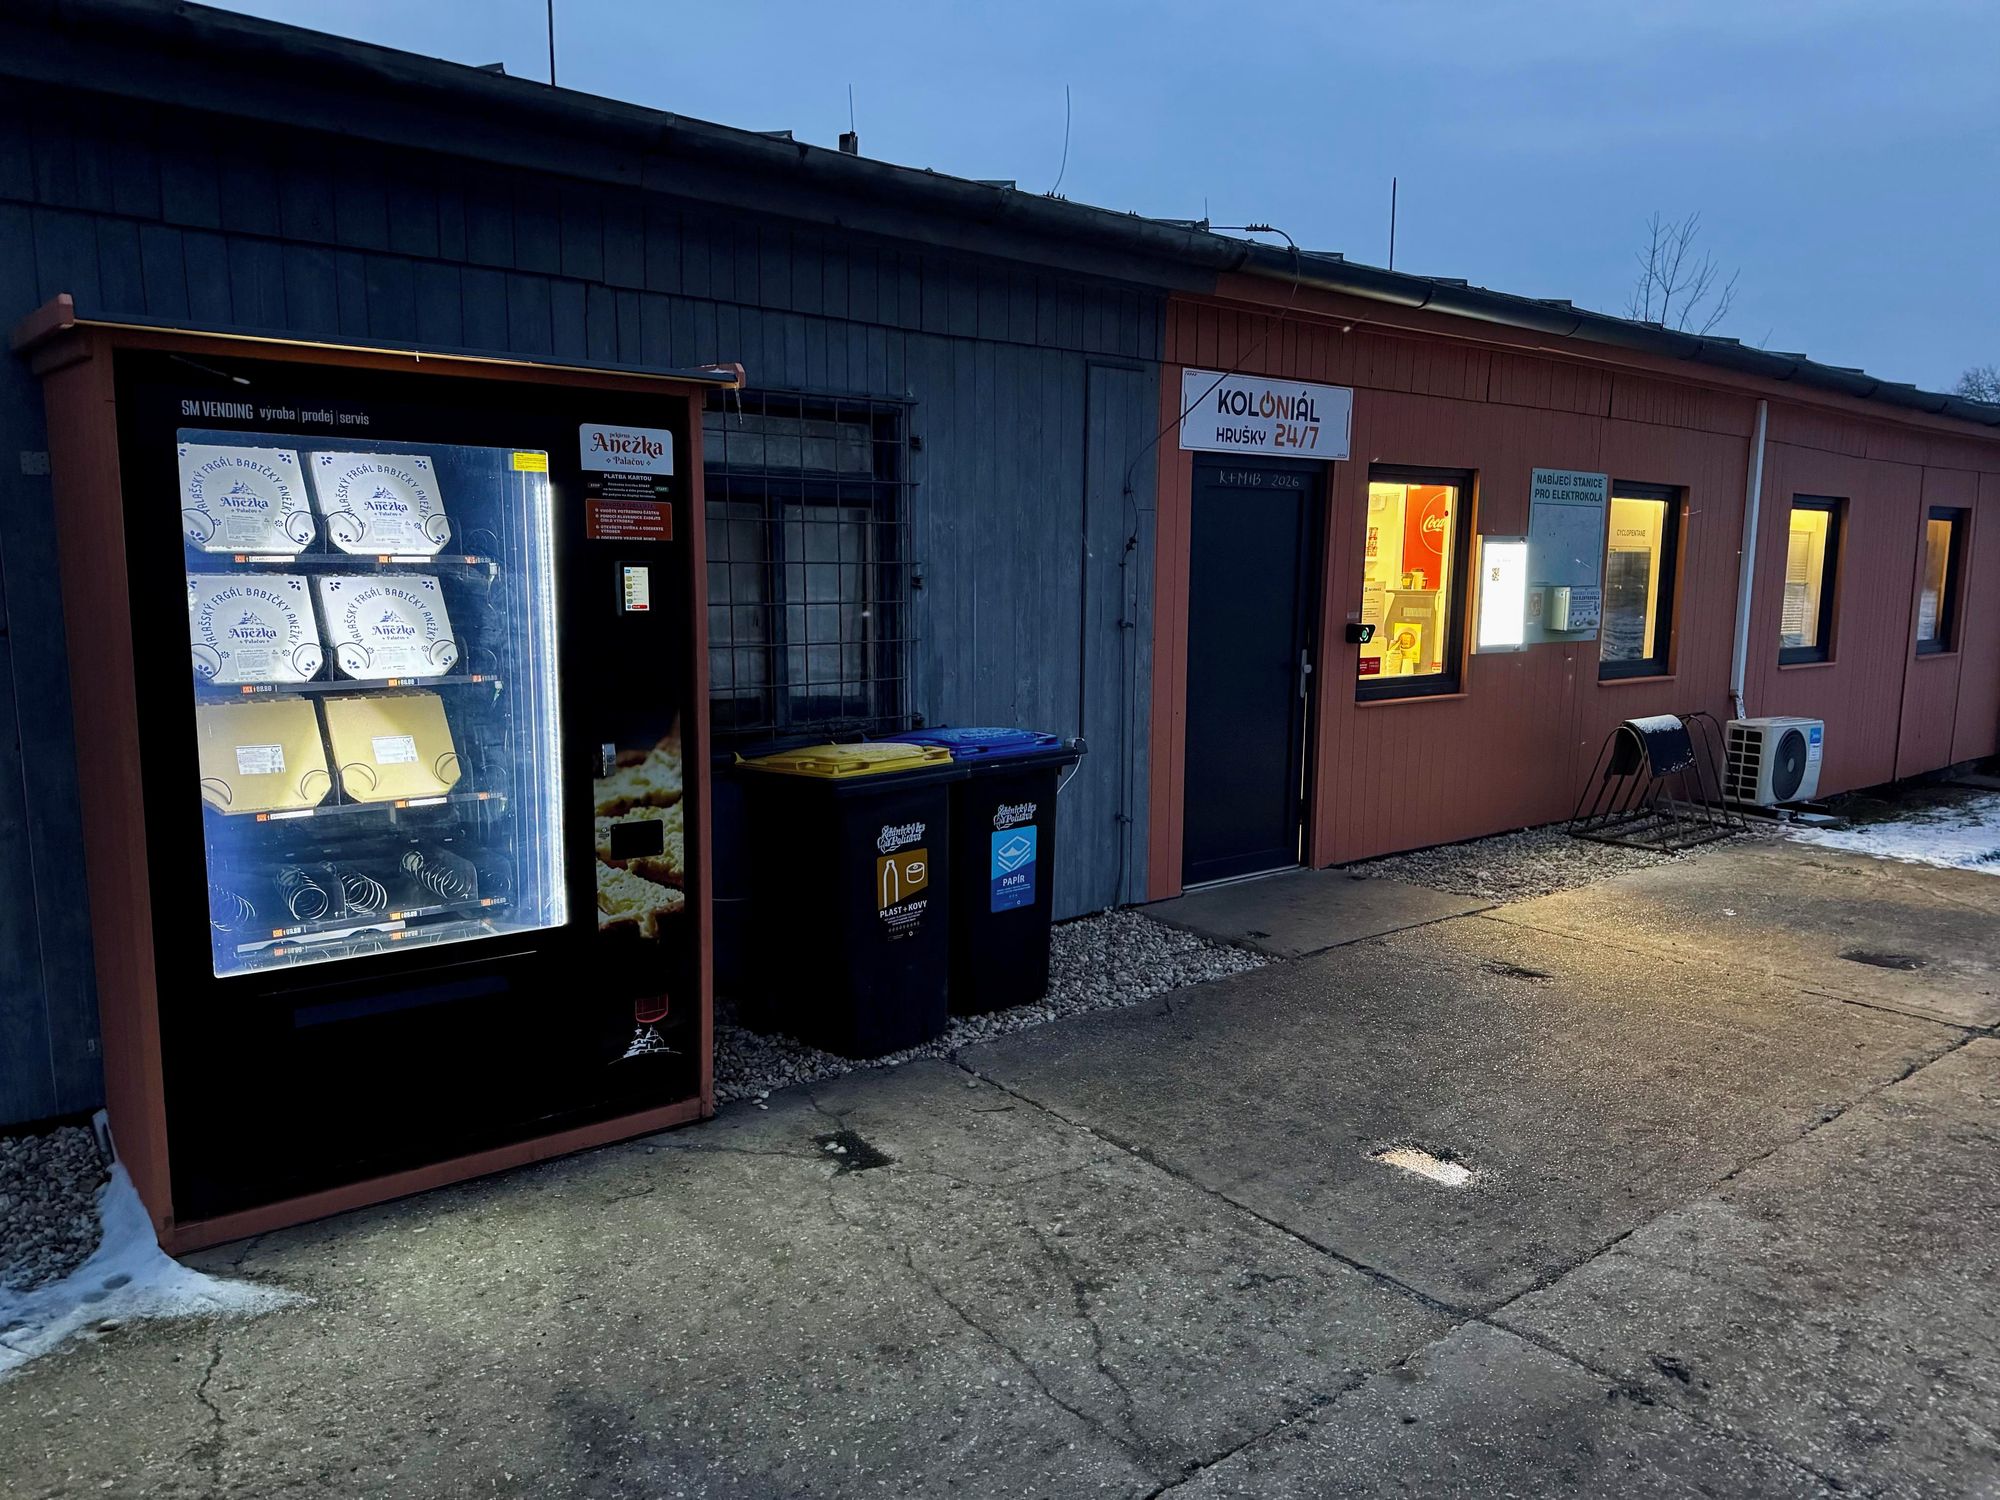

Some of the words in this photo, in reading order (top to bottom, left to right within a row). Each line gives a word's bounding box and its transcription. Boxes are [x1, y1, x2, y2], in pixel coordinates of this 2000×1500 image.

[181, 400, 200, 416] SM
[203, 402, 253, 419] VENDING
[260, 405, 295, 421] výroba
[302, 409, 333, 424] prodej
[340, 411, 369, 425] servis
[1218, 389, 1320, 422] KOLONIÁL
[1216, 425, 1266, 445] HRUŠKY
[1274, 423, 1320, 449] 24/7
[590, 433, 663, 459] Anežka
[613, 456, 645, 466] Palačov
[201, 456, 233, 475] FRGÁL
[236, 458, 283, 483] BABIČKY
[277, 485, 295, 516] ANEŽKY
[1272, 474, 1299, 487] 2026
[1536, 473, 1571, 486] NABÍJECÍ
[1573, 476, 1603, 488] STANICE
[346, 463, 374, 480] FRGÁL
[377, 465, 420, 488] BABIČKY
[415, 489, 432, 520] ANEŽKY
[1534, 489, 1550, 499] PRO
[1552, 490, 1603, 502] ELEKTROKOLA
[219, 496, 269, 509] Anežka
[364, 501, 408, 513] Anežka
[1616, 529, 1646, 537] CYCLOPENTANE
[198, 603, 220, 648] VALAŠSKÝ
[212, 586, 243, 606] FRGÁL
[246, 587, 291, 611] BABIČKY
[286, 613, 303, 646] ANEŽKY
[354, 587, 383, 605] FRGÁL
[385, 587, 426, 610] BABIČKY
[422, 611, 439, 643] ANEŽKY
[228, 627, 278, 640] Anežka
[372, 624, 416, 637] Anežka
[1002, 874, 1025, 887] PAPÍR
[879, 905, 902, 919] PLAST
[907, 900, 928, 912] KOVY
